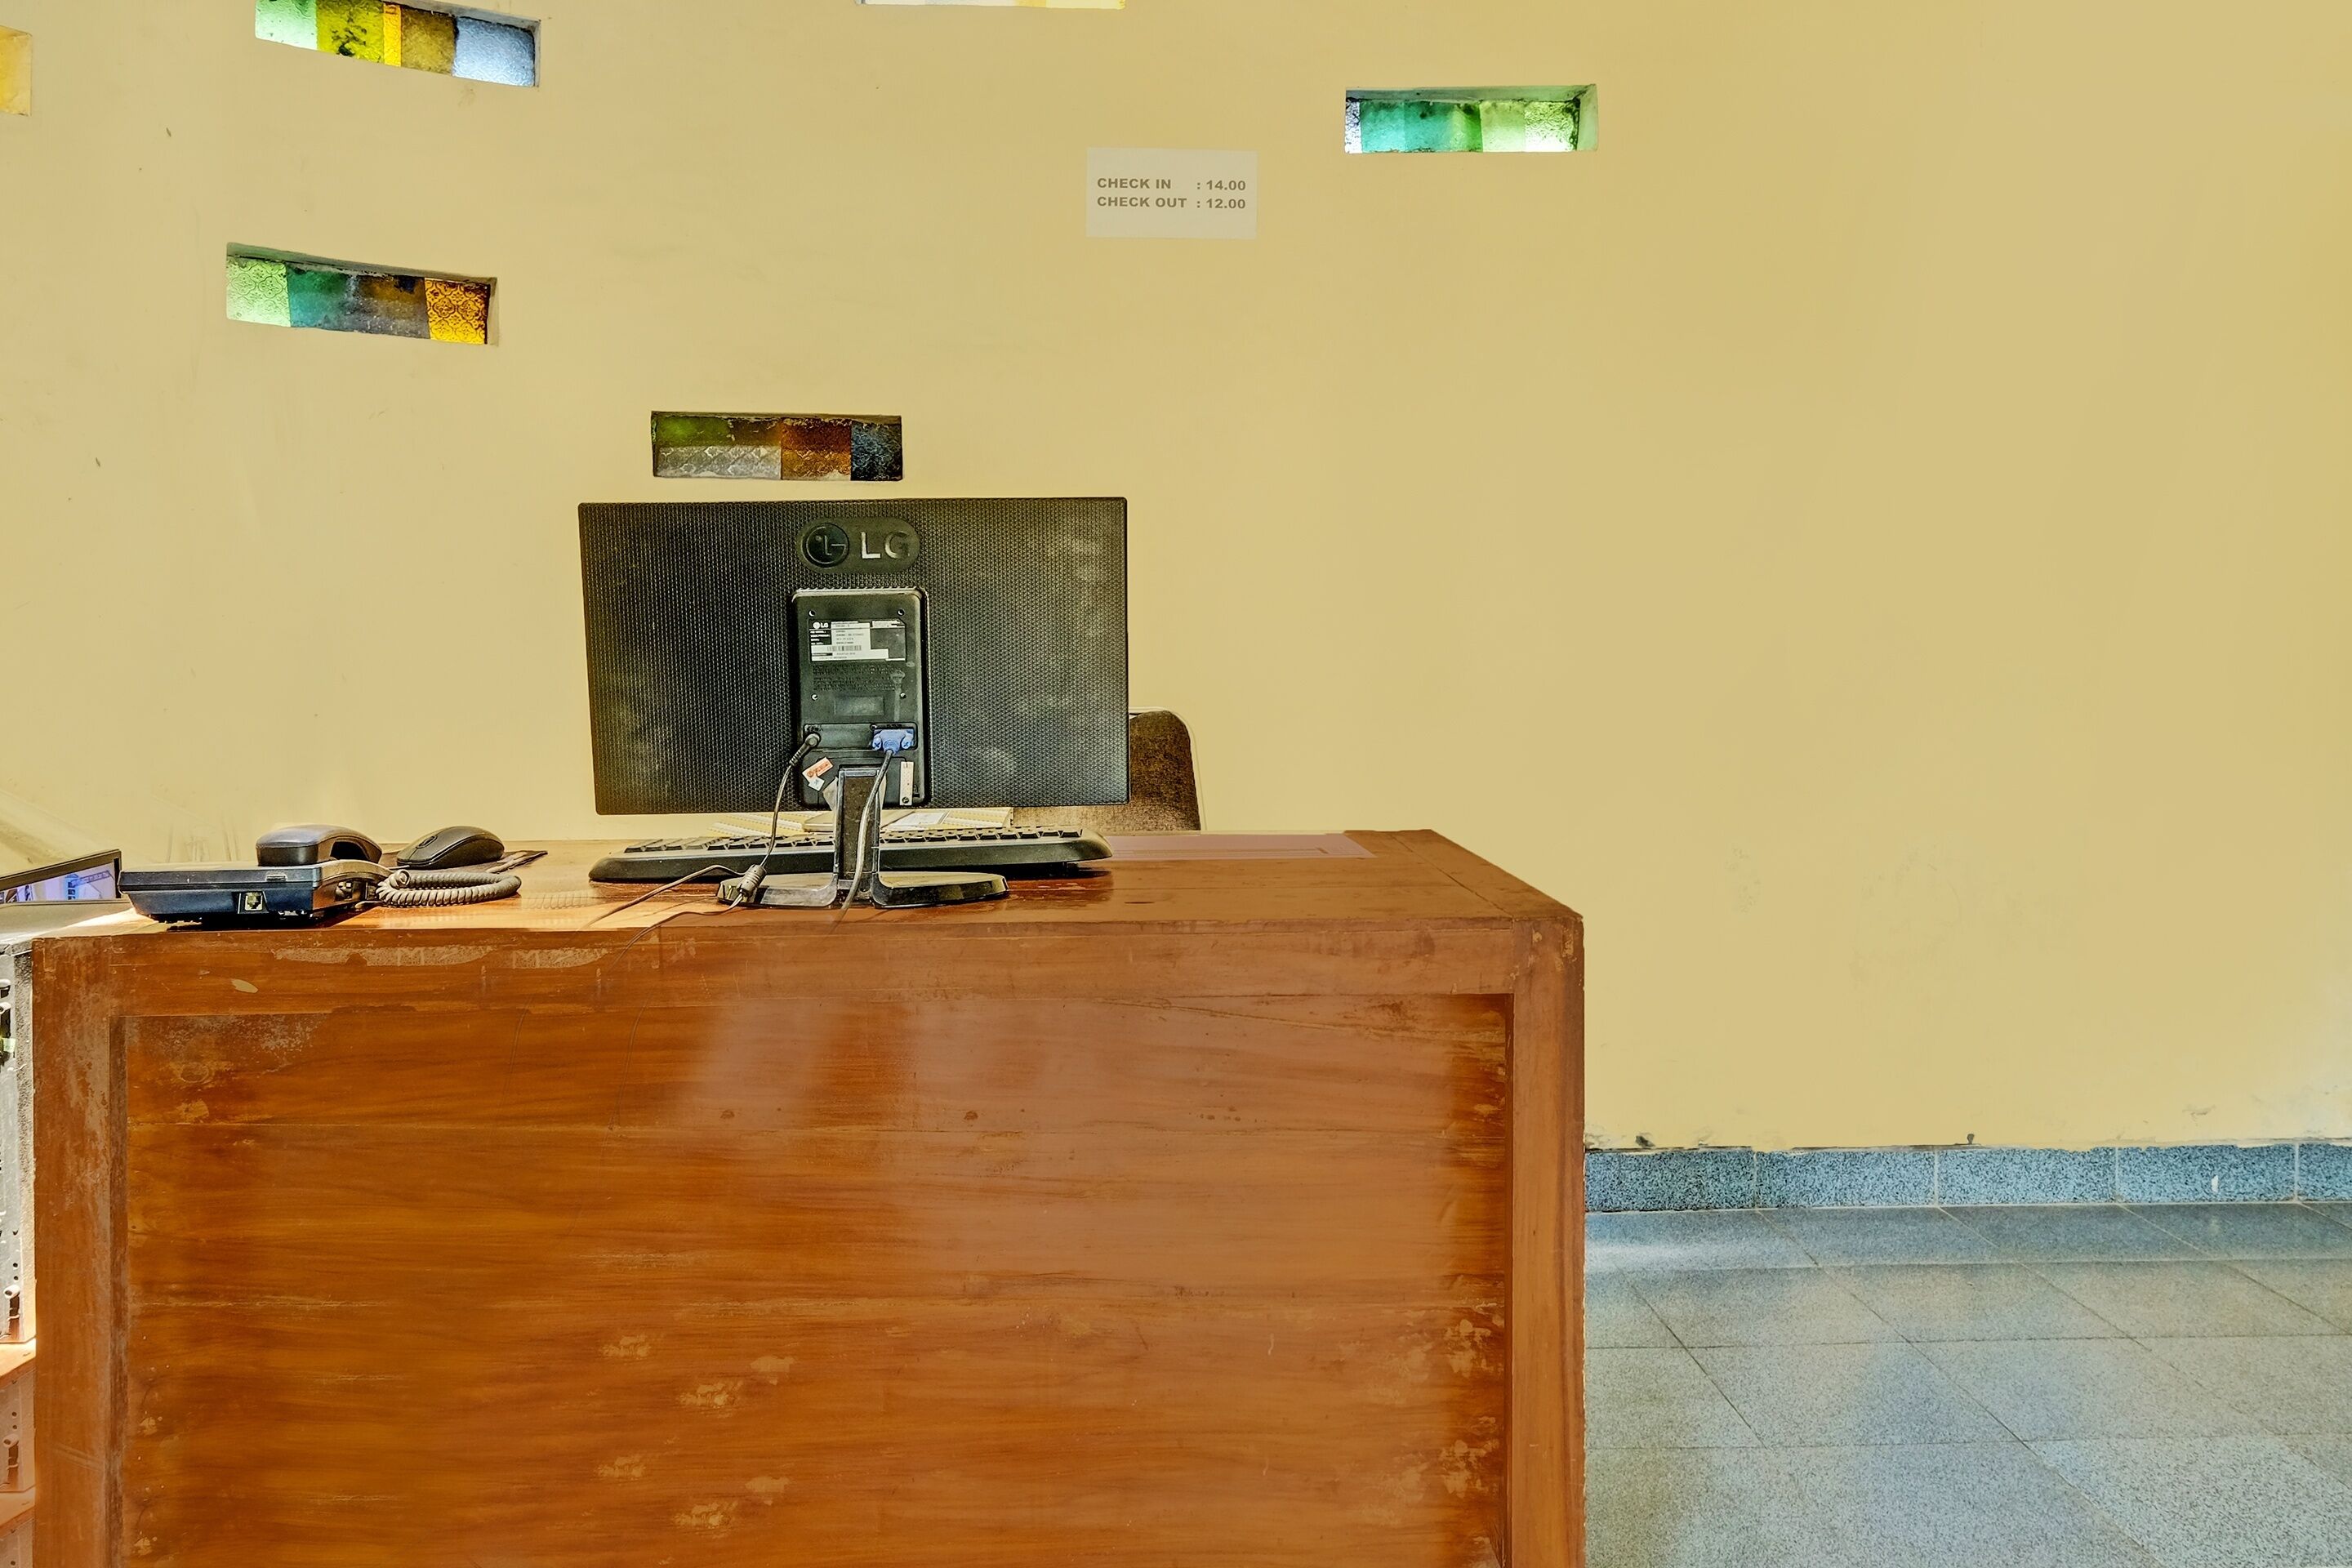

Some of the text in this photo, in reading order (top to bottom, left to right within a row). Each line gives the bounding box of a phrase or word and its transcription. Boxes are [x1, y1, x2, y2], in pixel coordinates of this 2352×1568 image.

[1097, 178, 1150, 189] CHECK
[1156, 179, 1171, 189] IN
[1206, 180, 1246, 190] 14.00
[1097, 196, 1150, 207] CHECK
[1155, 198, 1187, 207] OUT
[1205, 198, 1246, 209] 12.00
[860, 531, 911, 559] LG
